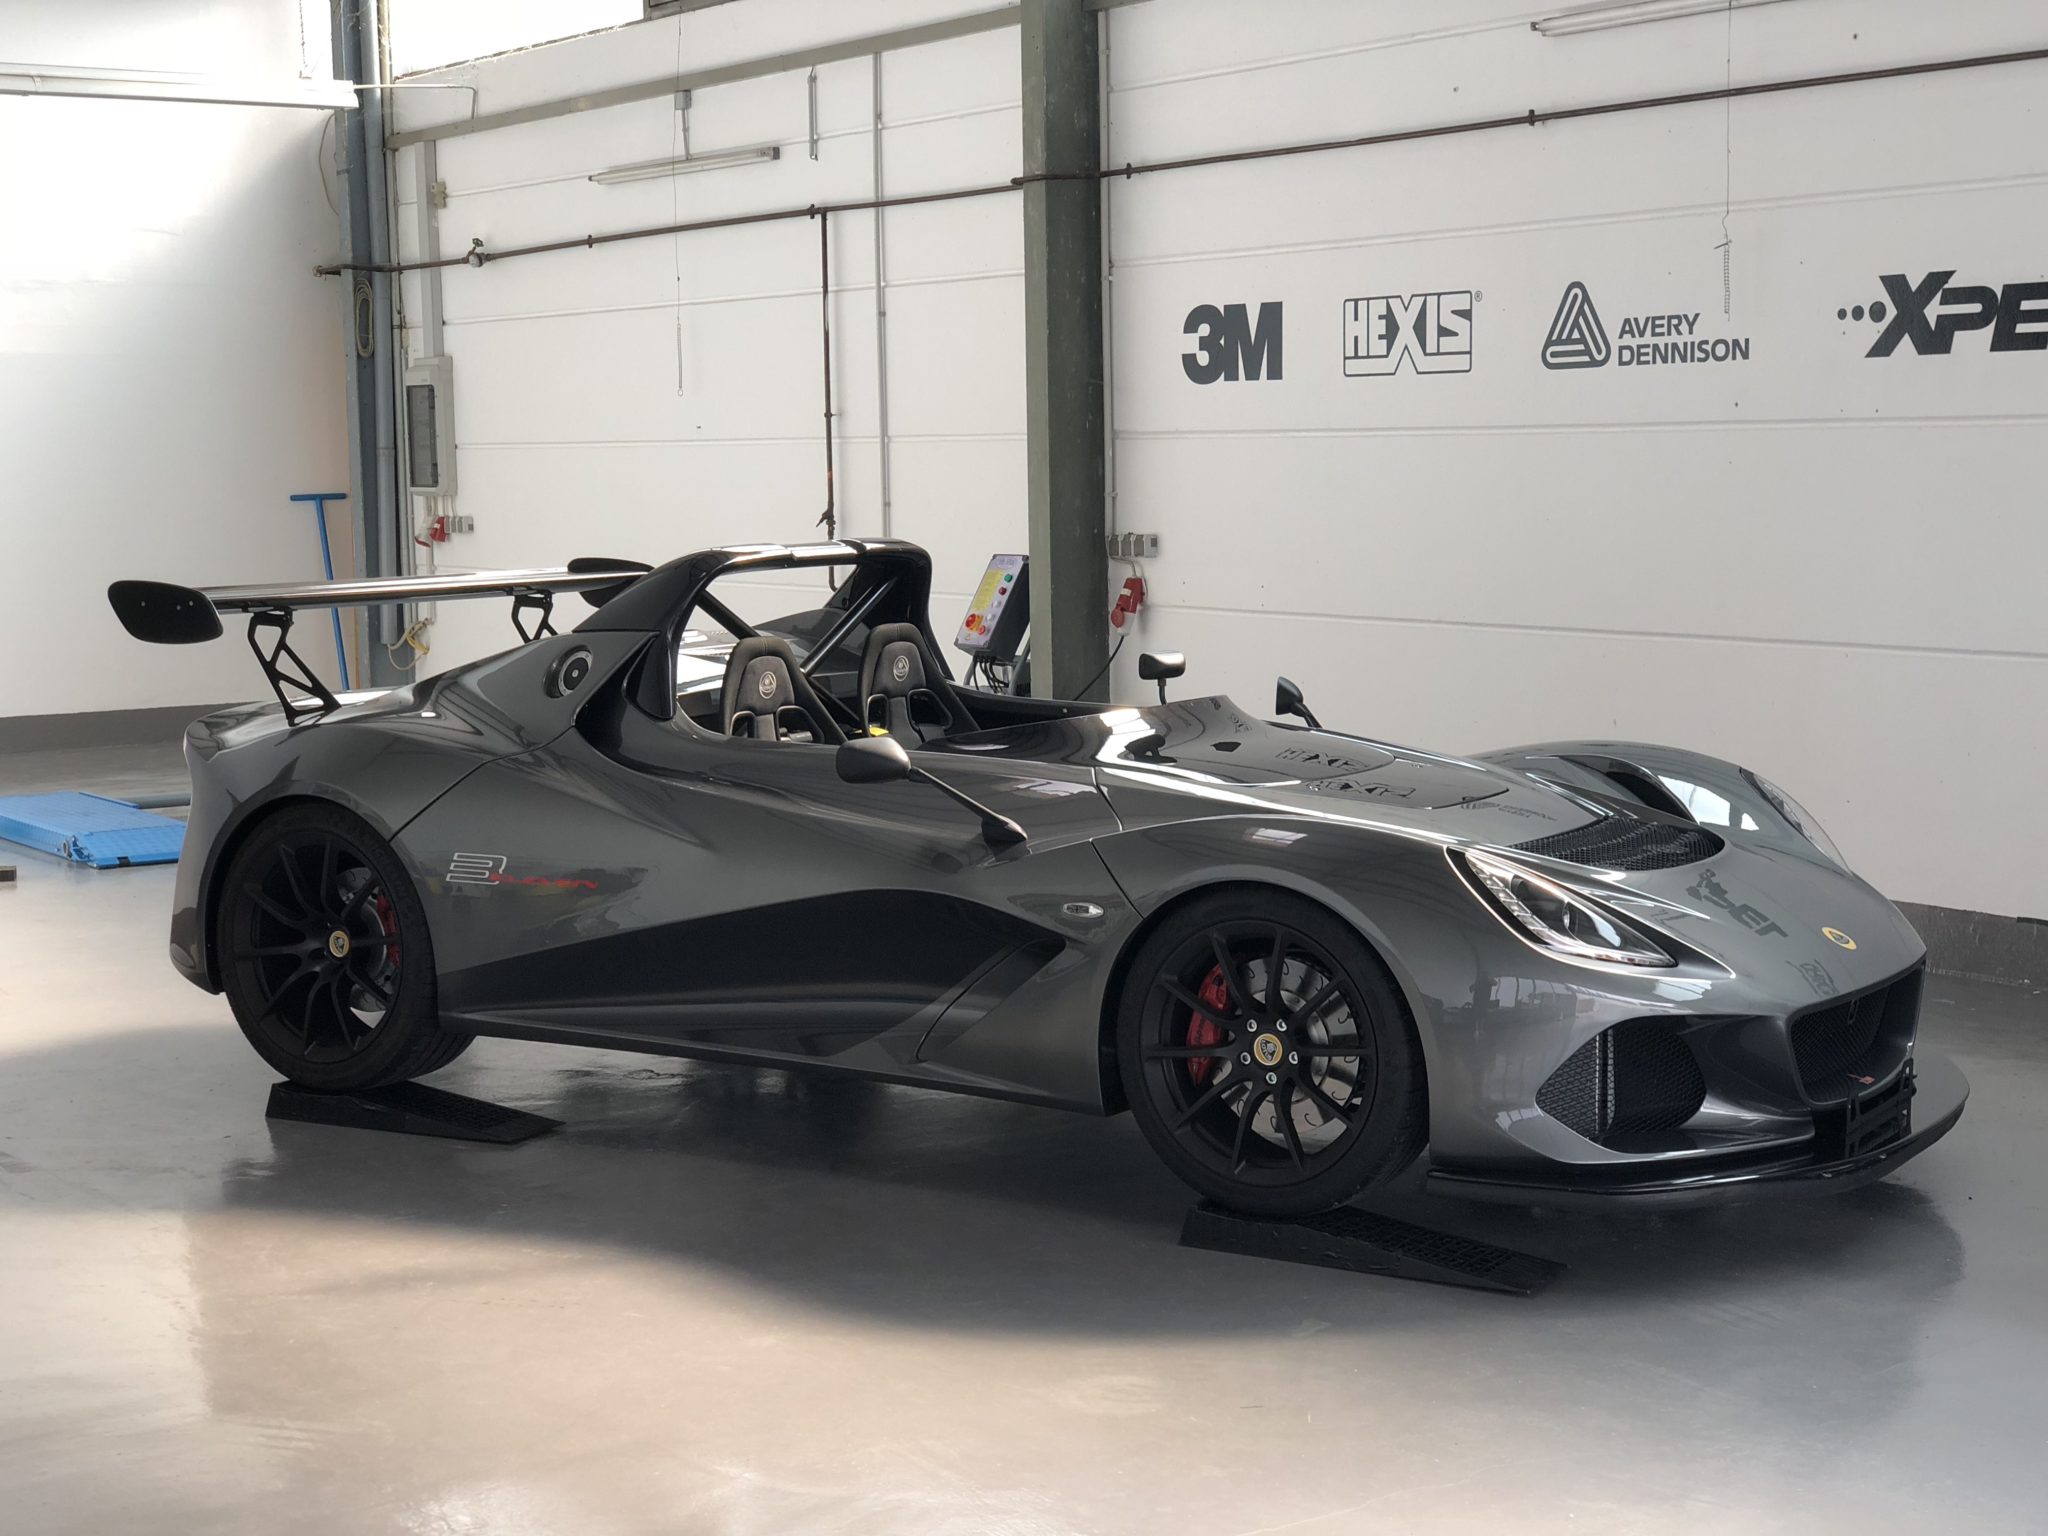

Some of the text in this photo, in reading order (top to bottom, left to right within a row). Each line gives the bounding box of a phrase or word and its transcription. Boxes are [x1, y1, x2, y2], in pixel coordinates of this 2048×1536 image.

[1181, 301, 1283, 385] 3M
[1344, 290, 1472, 377] HEXIS
[1618, 313, 1701, 339] AVERY
[1618, 338, 1750, 367] DENNISON
[1864, 270, 2048, 358] XPE
